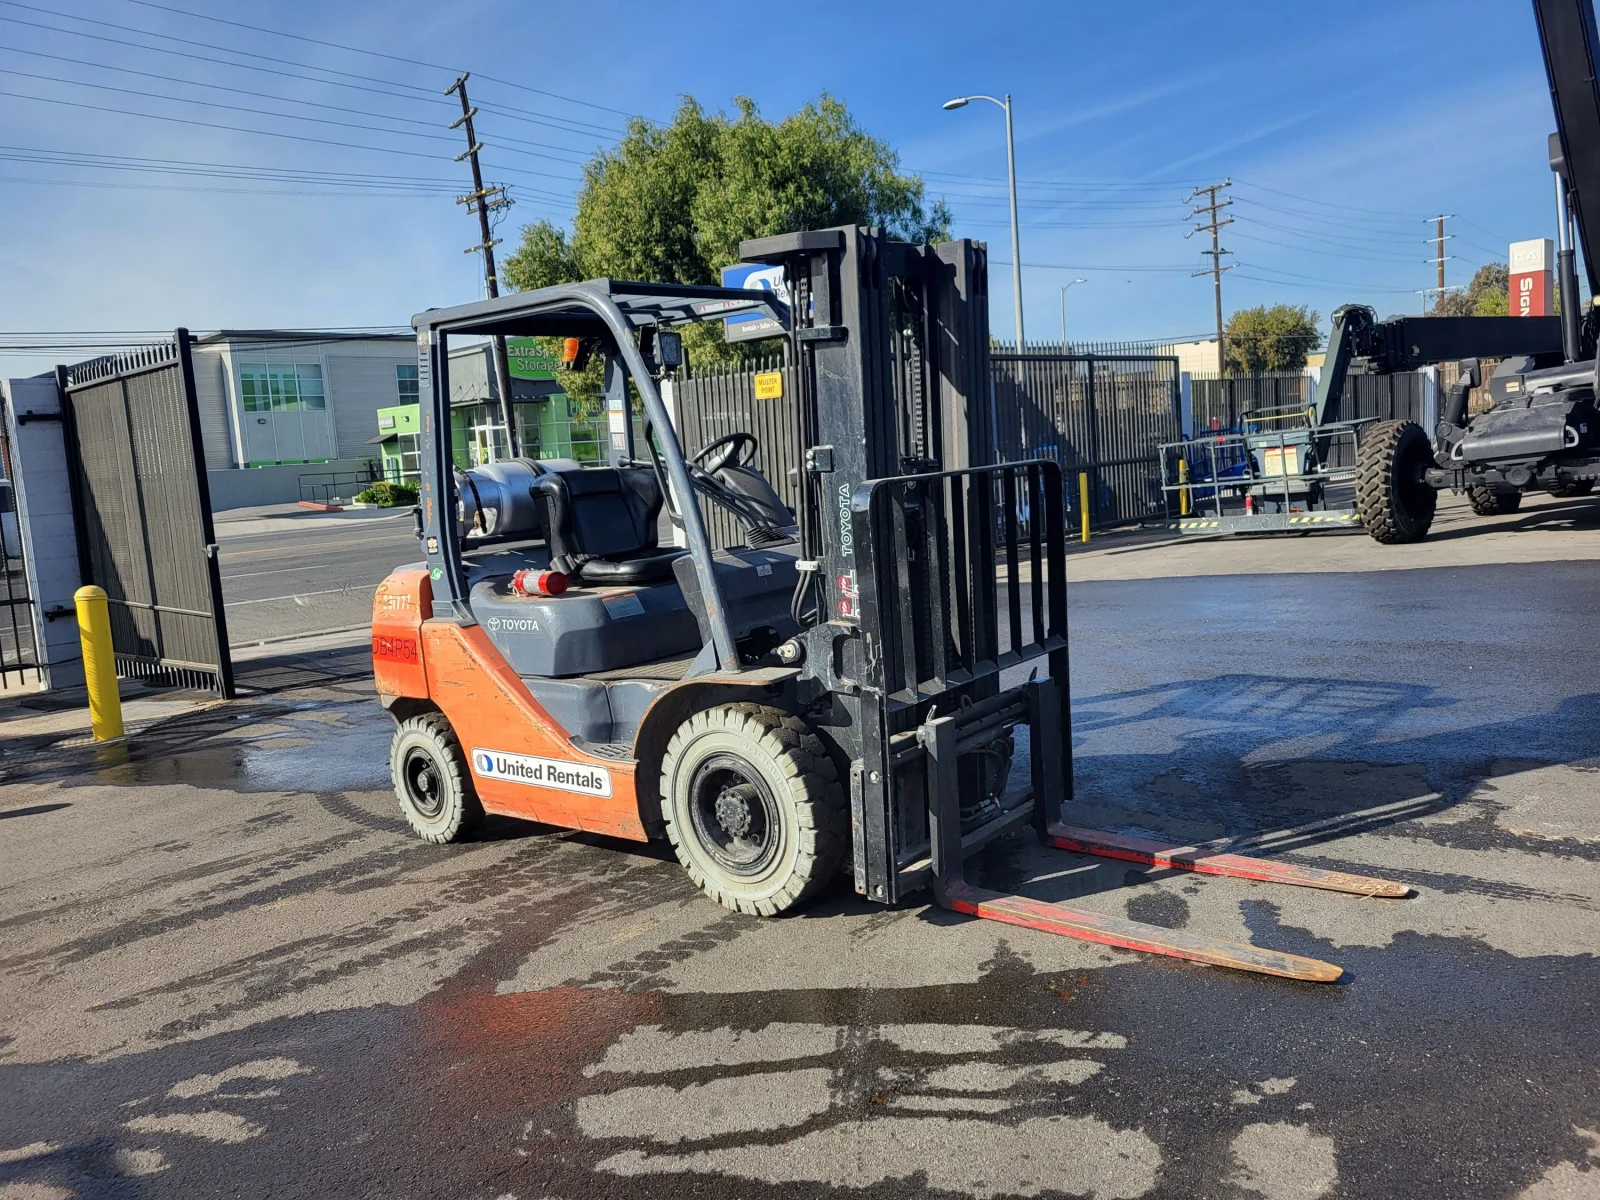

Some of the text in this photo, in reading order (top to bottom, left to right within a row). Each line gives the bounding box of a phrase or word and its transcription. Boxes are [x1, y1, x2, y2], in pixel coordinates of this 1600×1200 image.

[517, 358, 560, 373] Storage
[758, 377, 778, 386] MUSTER
[761, 386, 775, 394] POINT
[839, 482, 853, 557] TOYOTA
[501, 619, 540, 631] TOYOTA
[496, 757, 603, 790] United Rentals
